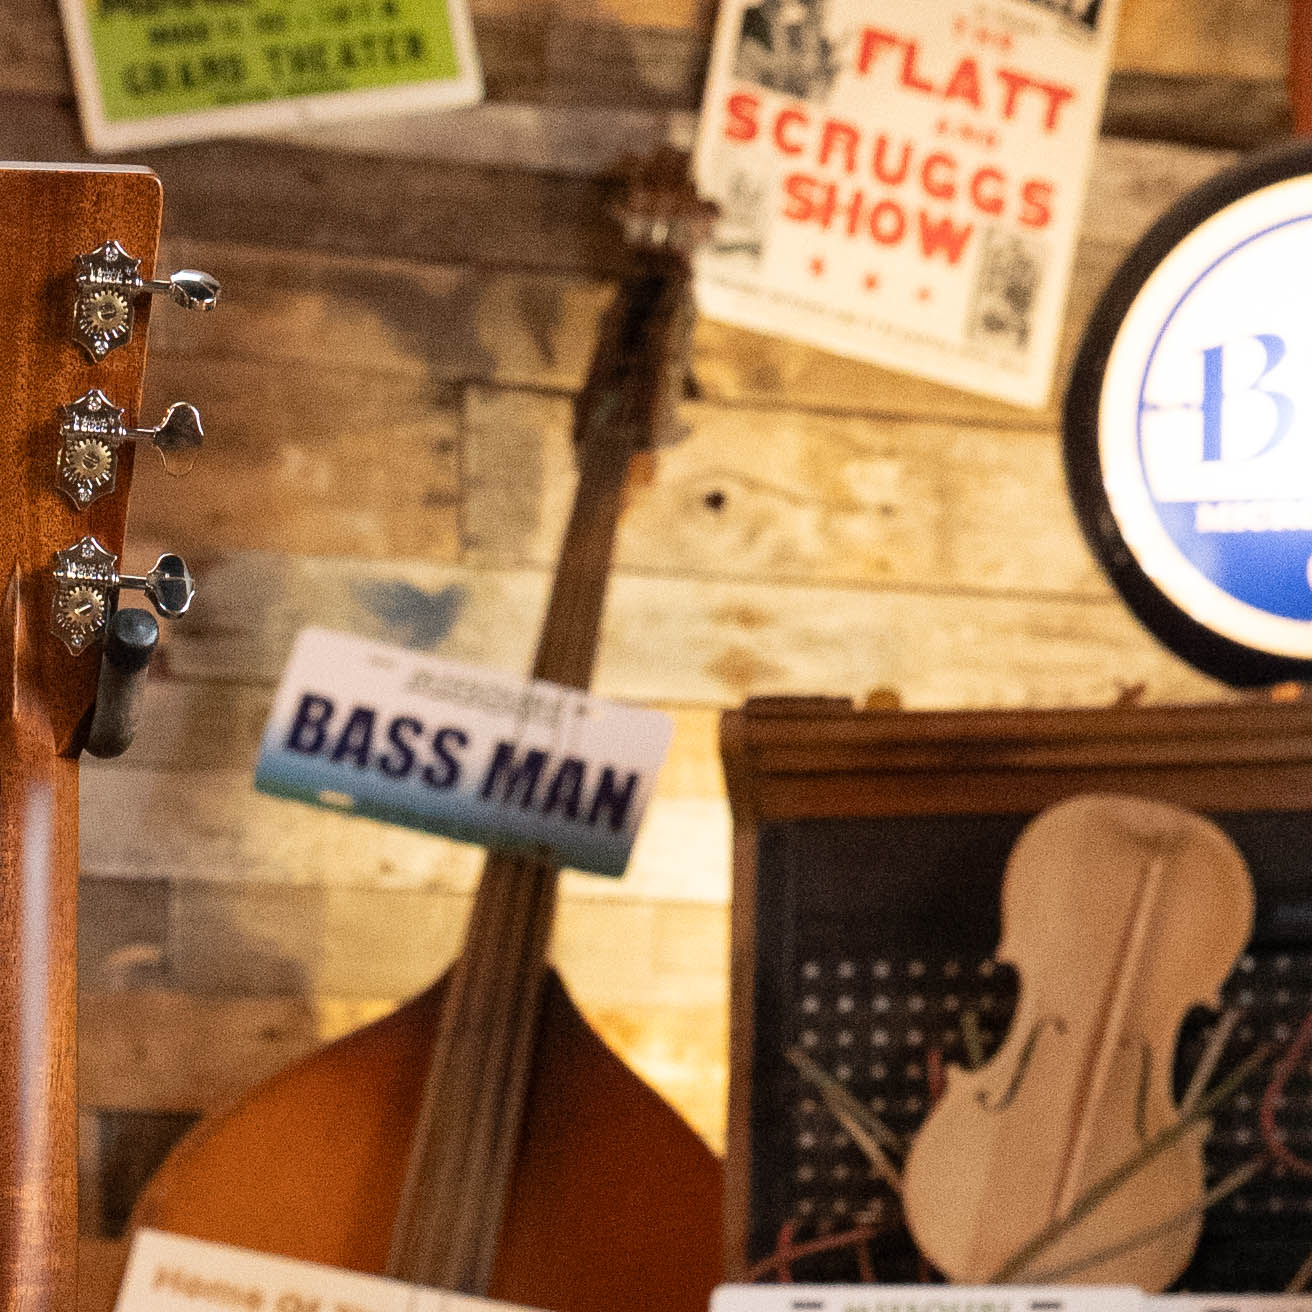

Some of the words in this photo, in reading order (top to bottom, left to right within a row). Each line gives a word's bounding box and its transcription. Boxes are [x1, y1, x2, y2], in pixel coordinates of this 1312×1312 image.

[856, 25, 1076, 133] FLATT
[724, 92, 1056, 229] SCRUGGS
[782, 172, 974, 266] SHOW
[286, 692, 470, 791] BASS
[479, 740, 640, 836] MAN
